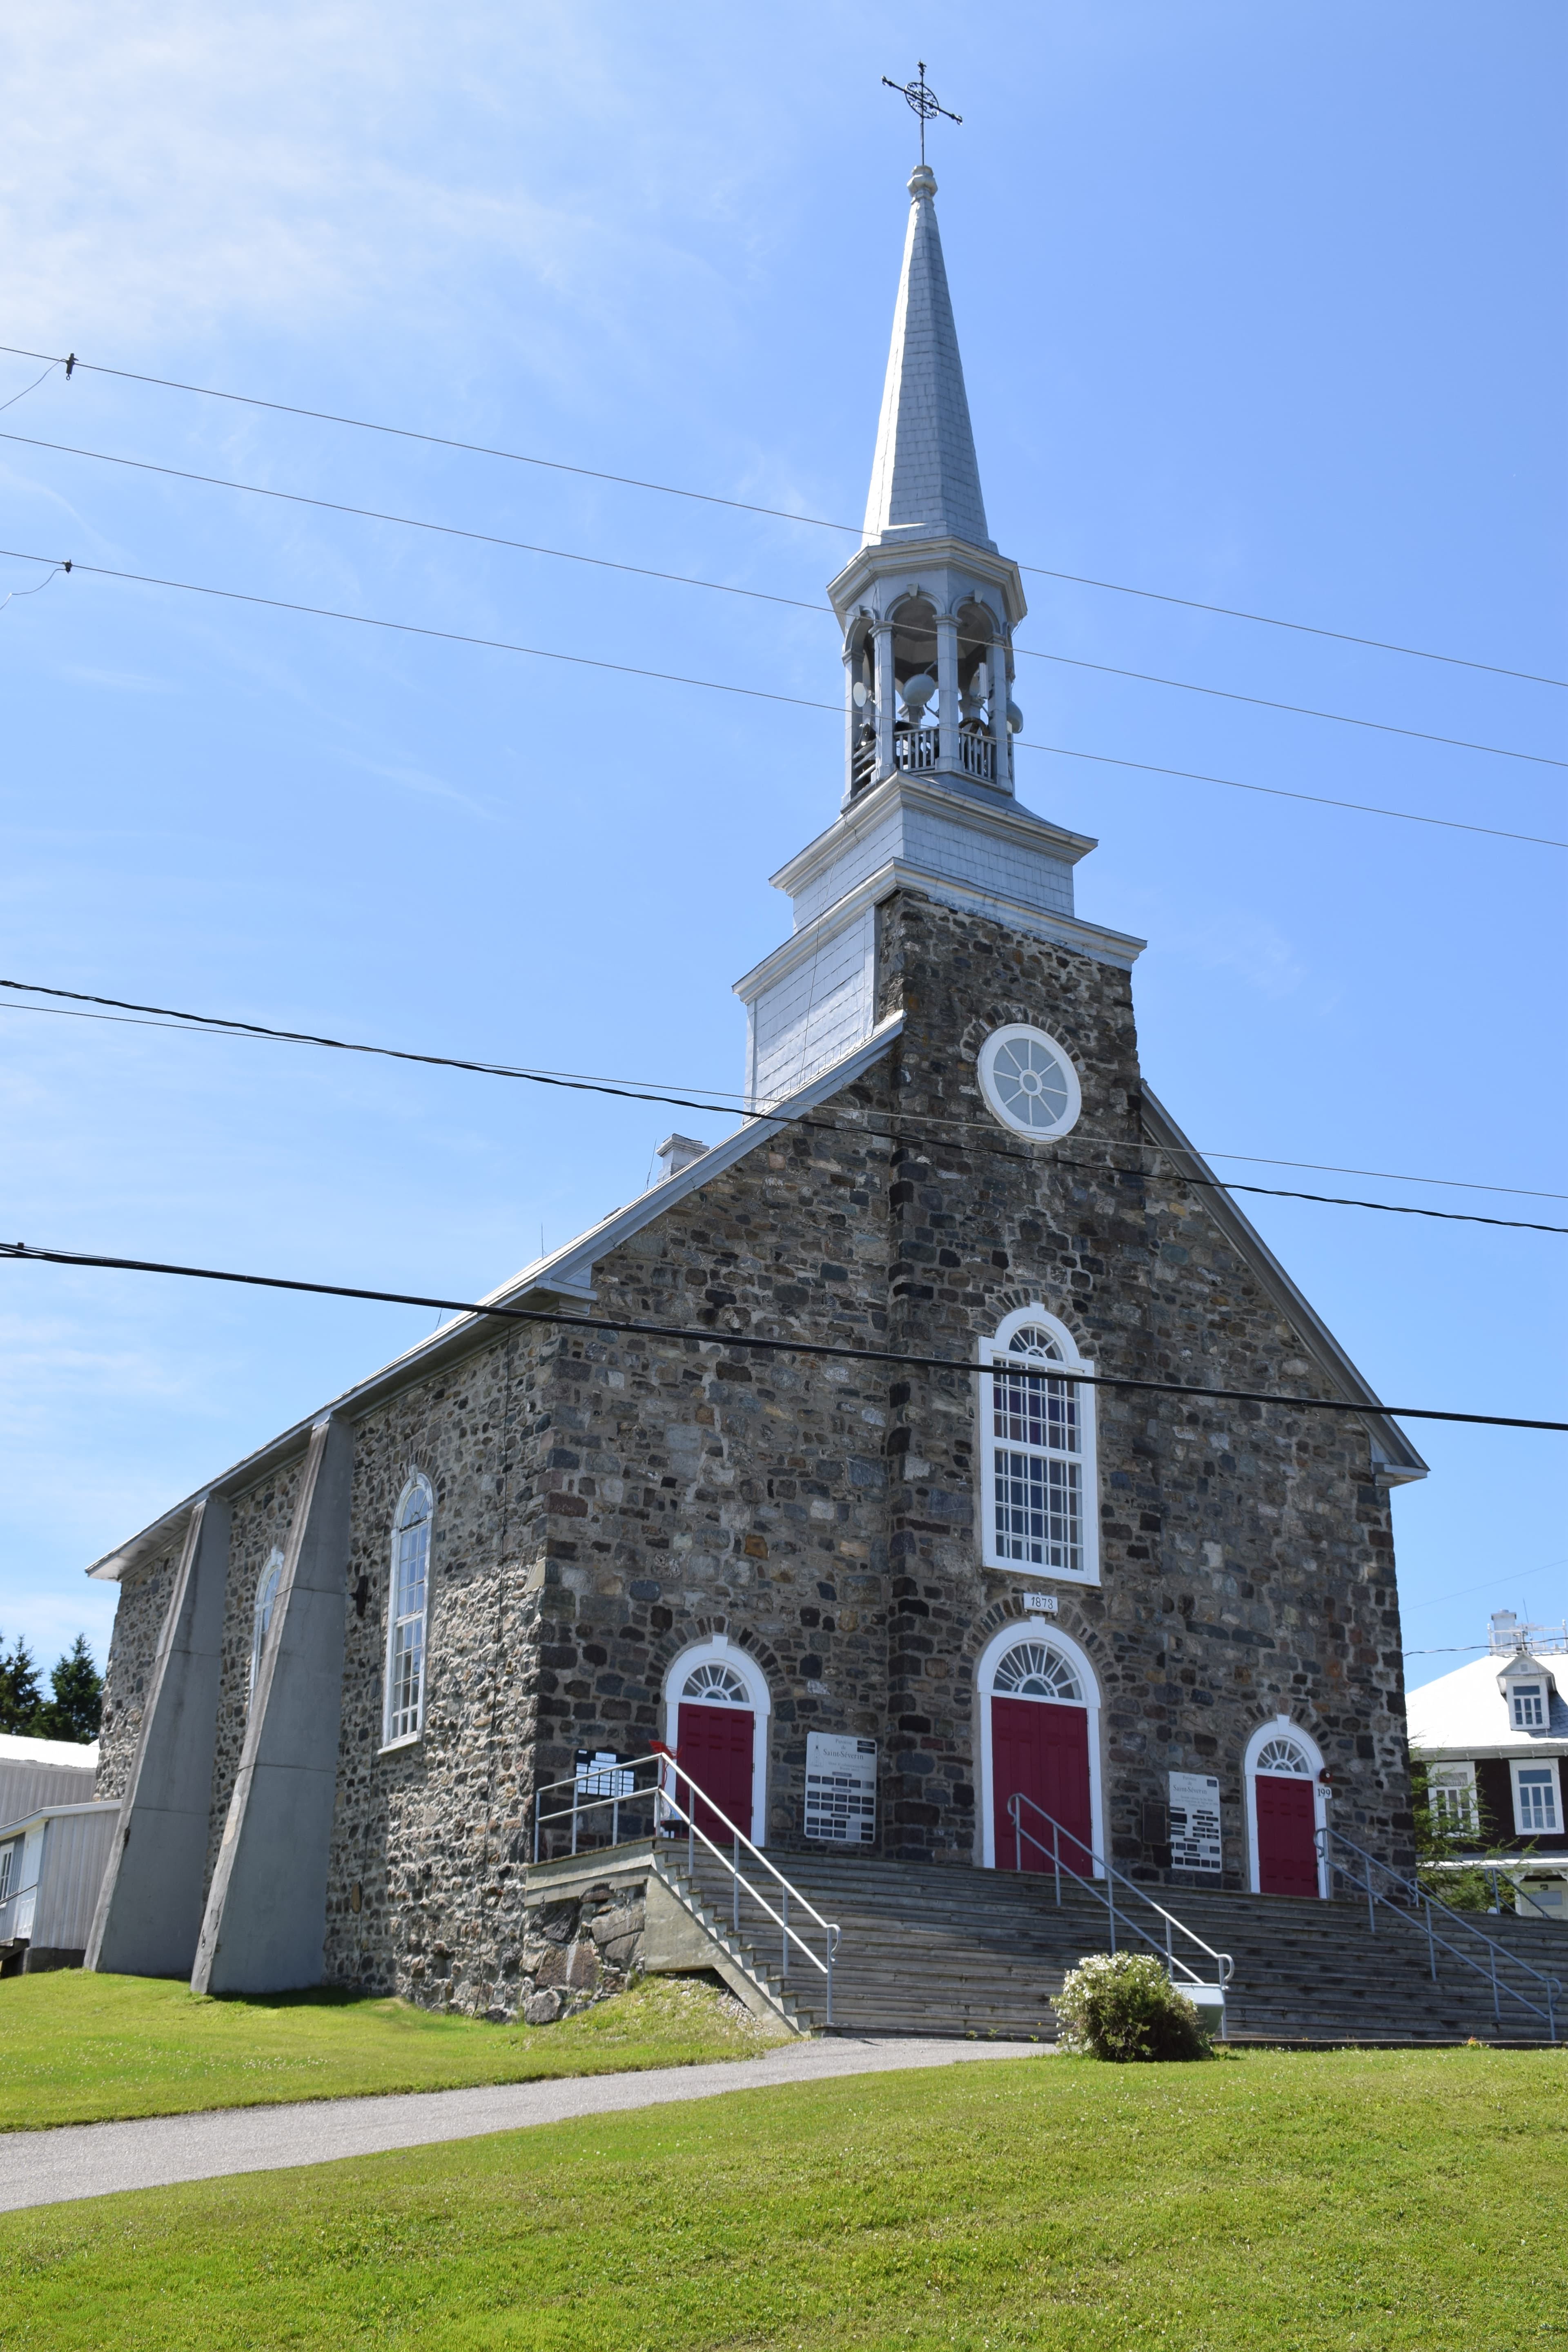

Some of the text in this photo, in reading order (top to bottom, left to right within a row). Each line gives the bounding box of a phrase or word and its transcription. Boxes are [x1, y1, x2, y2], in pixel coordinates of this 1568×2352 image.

[1031, 1597, 1053, 1609] 1873
[823, 1748, 864, 1760] Saint-Séverin
[1173, 1785, 1207, 1794] Saint-Séverin
[1318, 1788, 1330, 1797] 199
